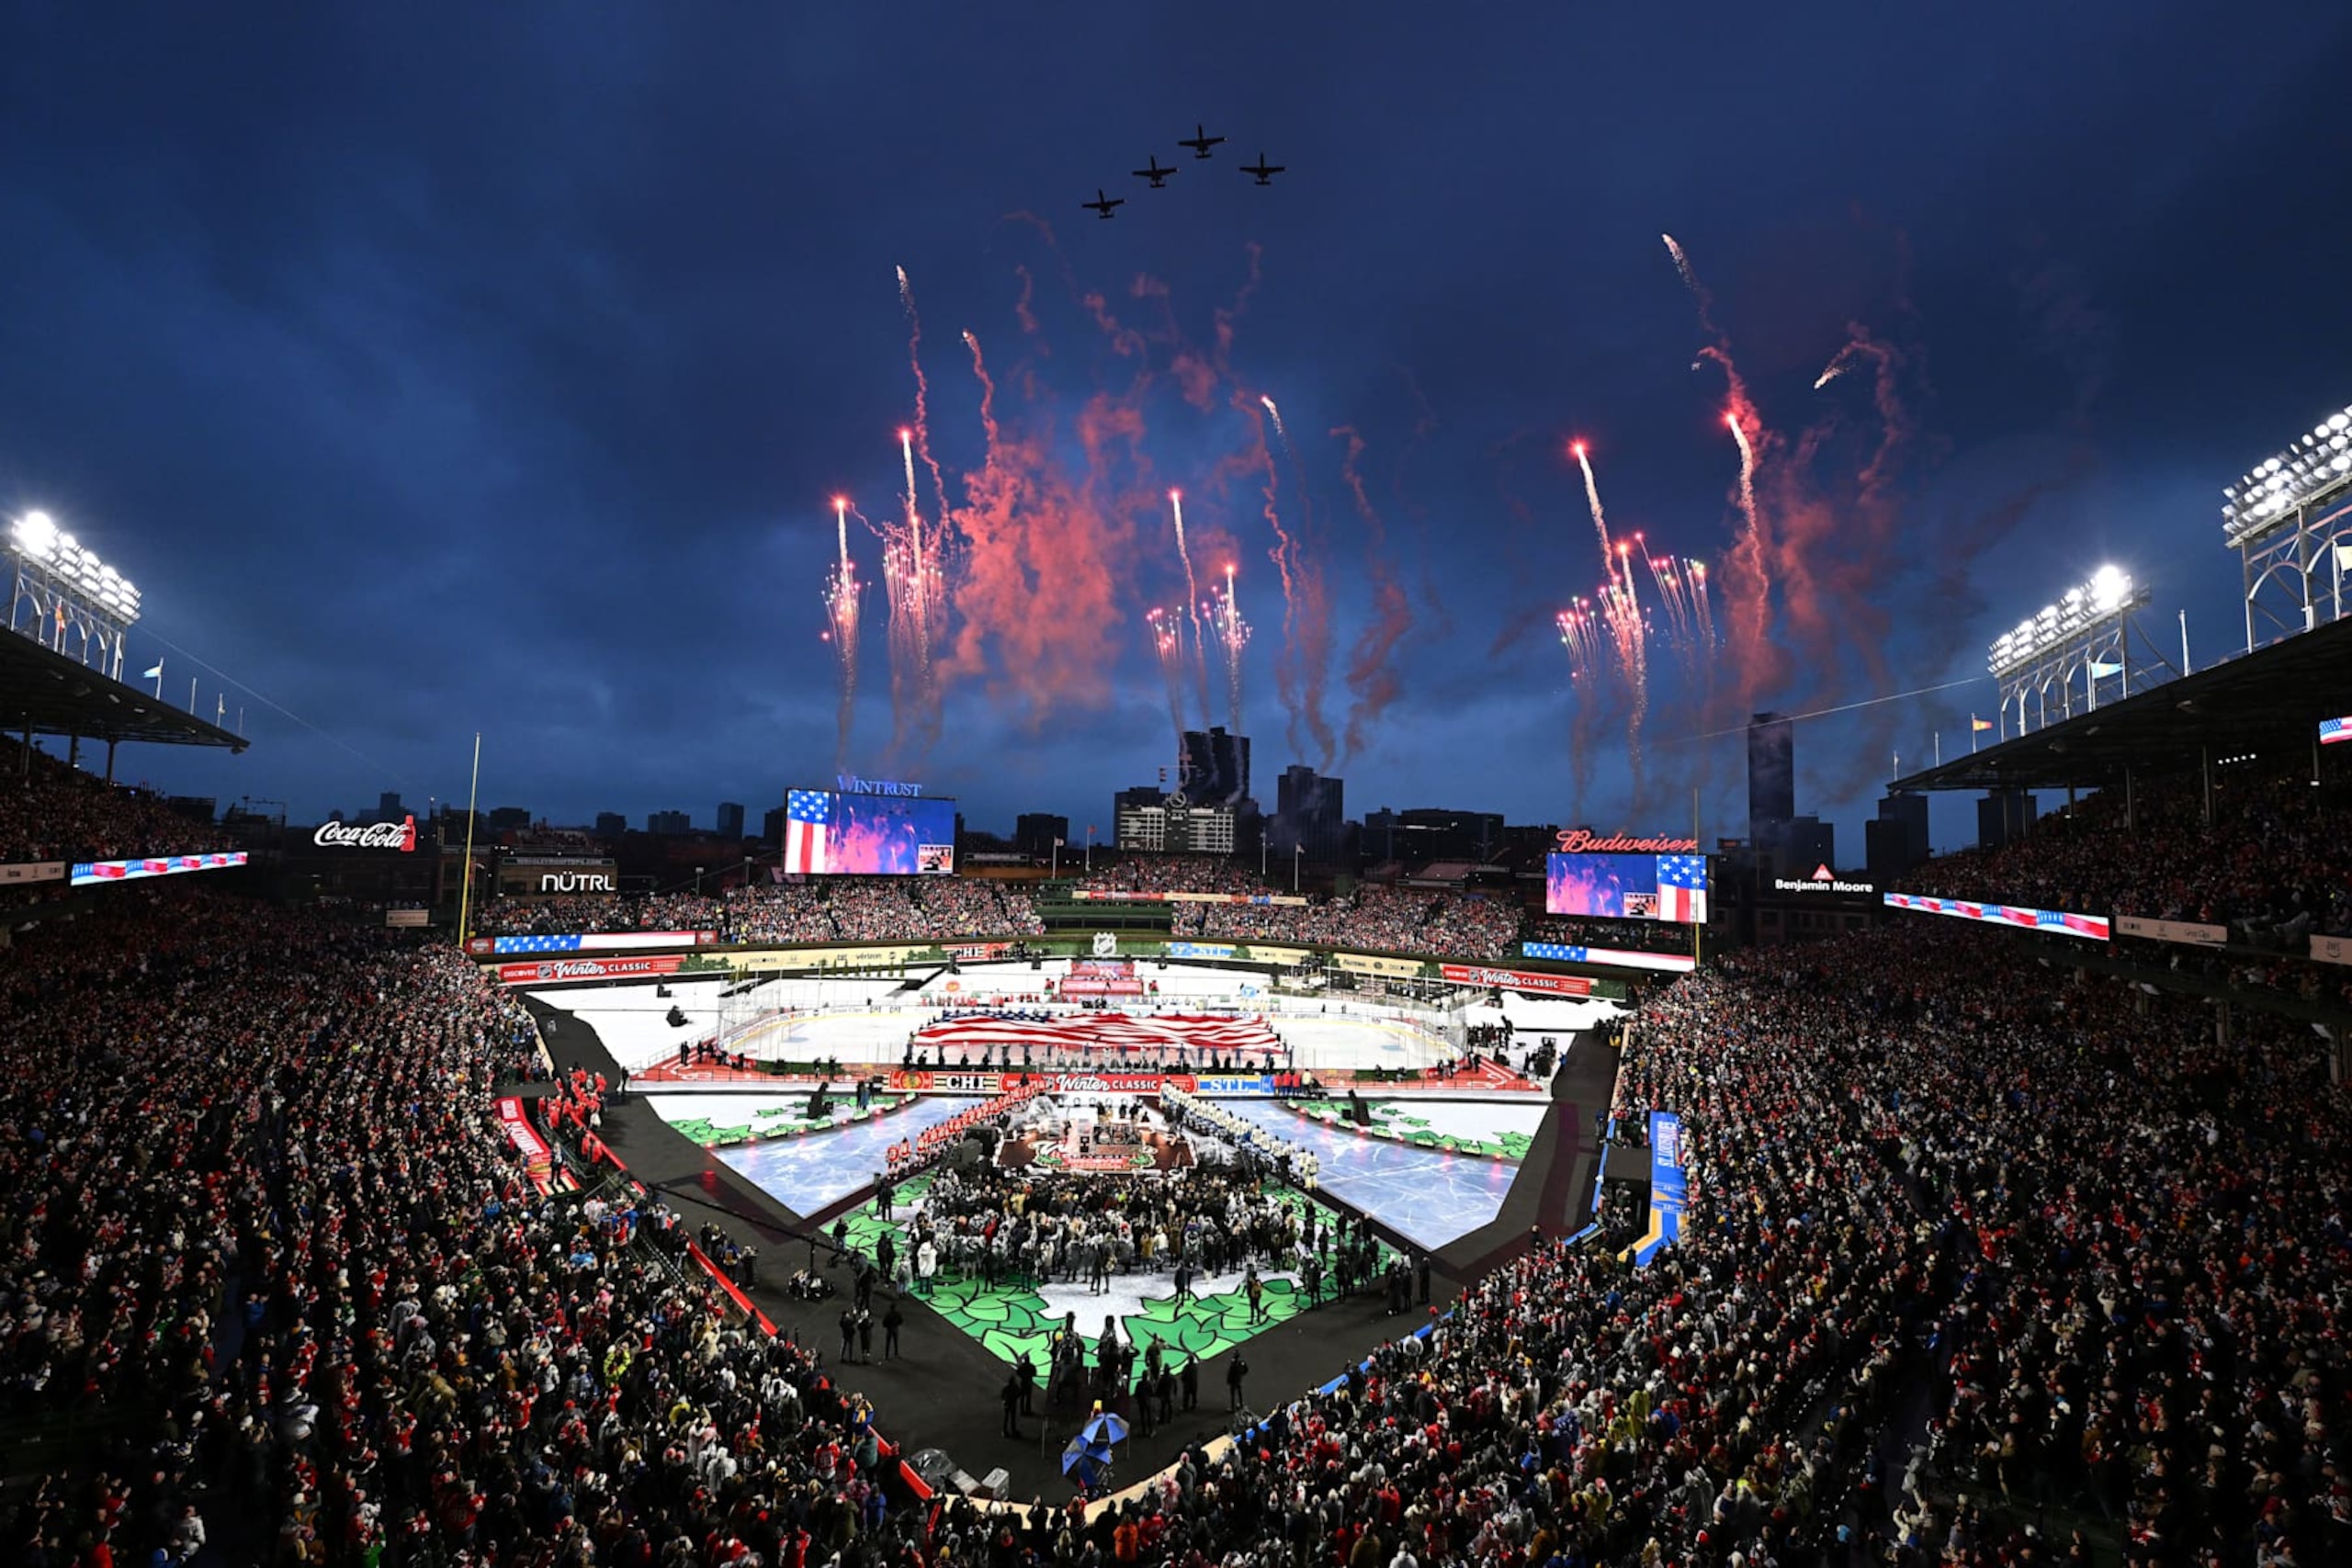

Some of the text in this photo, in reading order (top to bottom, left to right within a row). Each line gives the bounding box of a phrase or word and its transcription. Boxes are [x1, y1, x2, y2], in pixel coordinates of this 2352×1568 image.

[836, 774, 922, 797] WINTRUST
[313, 820, 411, 847] Coca-Cola
[1555, 829, 1698, 852] Budweiser
[1774, 878, 1873, 893] Benjamin Moore
[554, 960, 606, 979] Winter
[607, 962, 651, 972] CLASSIC
[1480, 969, 1521, 987] Winter
[1521, 978, 1559, 988] CLASSIC
[945, 1075, 986, 1090] CHI
[1056, 1074, 1110, 1094] Winter
[1111, 1079, 1158, 1090] CLASSIC
[1210, 1077, 1249, 1093] STL
